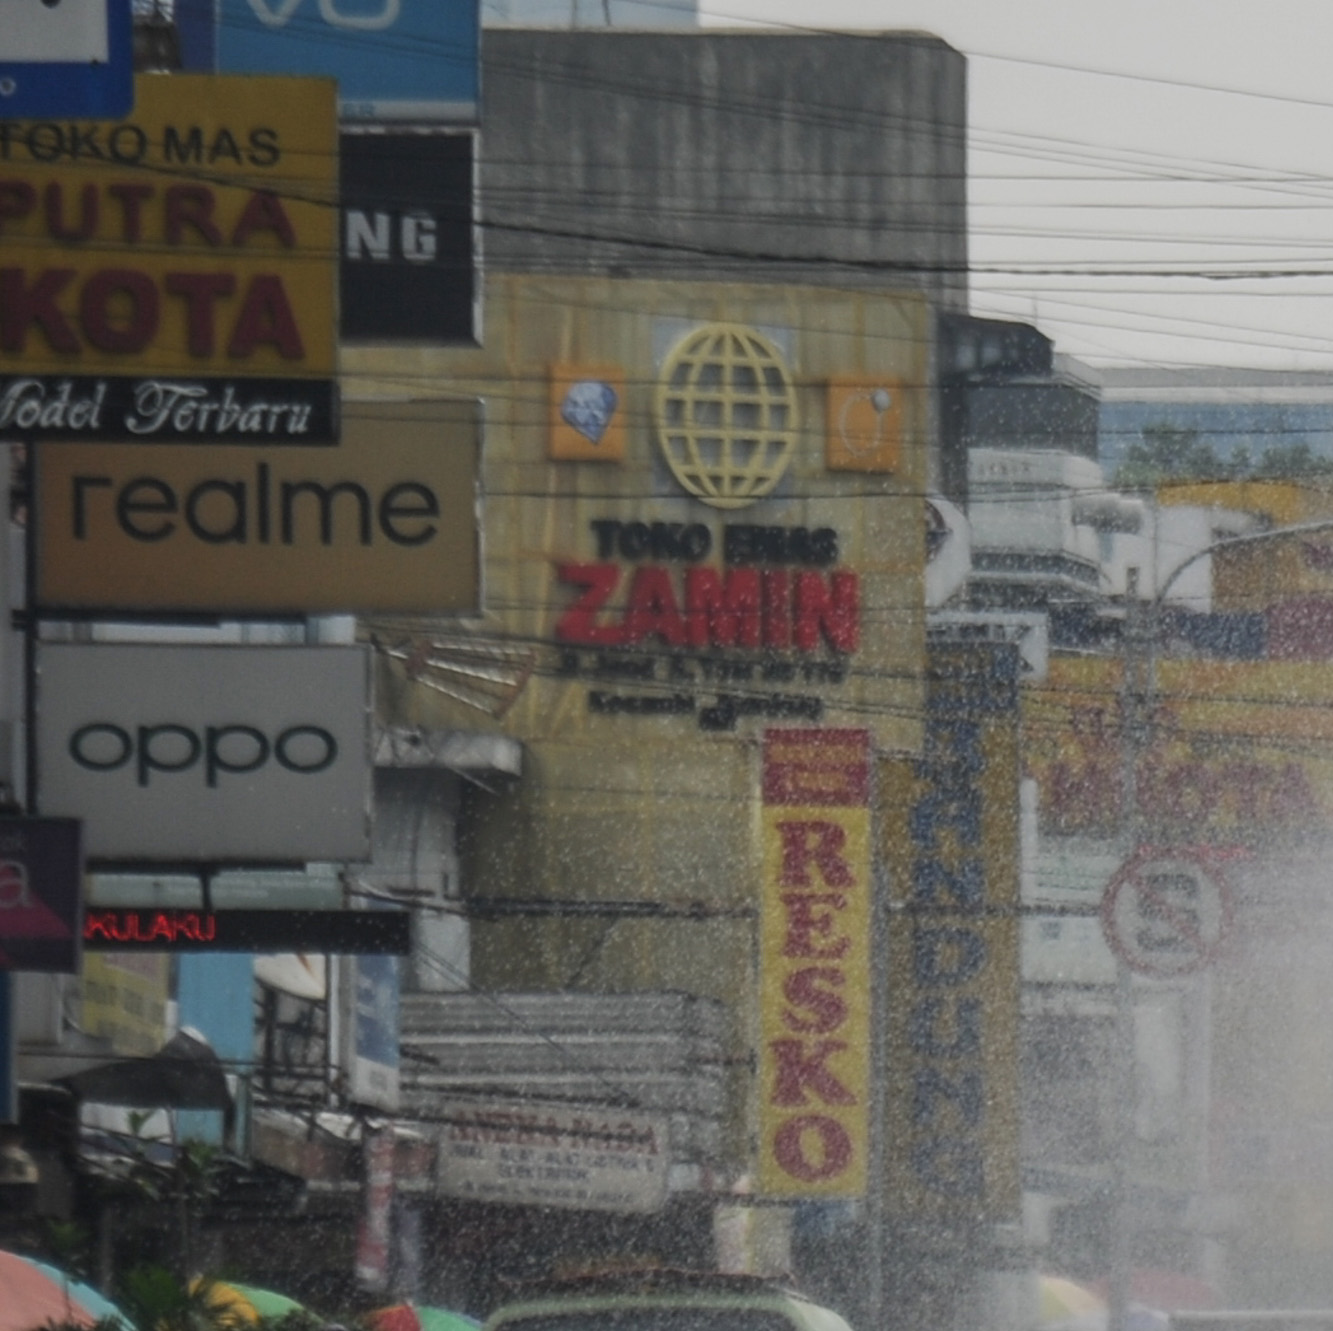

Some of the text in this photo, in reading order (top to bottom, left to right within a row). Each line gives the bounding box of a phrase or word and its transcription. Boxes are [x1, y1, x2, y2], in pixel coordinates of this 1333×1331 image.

[0, 123, 281, 166] TOKO MAS
[0, 180, 297, 249] PUTRA
[0, 267, 306, 361] KOTA
[125, 381, 312, 435] Terbaru
[69, 463, 442, 547] realme
[556, 562, 861, 654] ZAMIN
[69, 723, 338, 788] oppo
[770, 821, 859, 1183] RESKO
